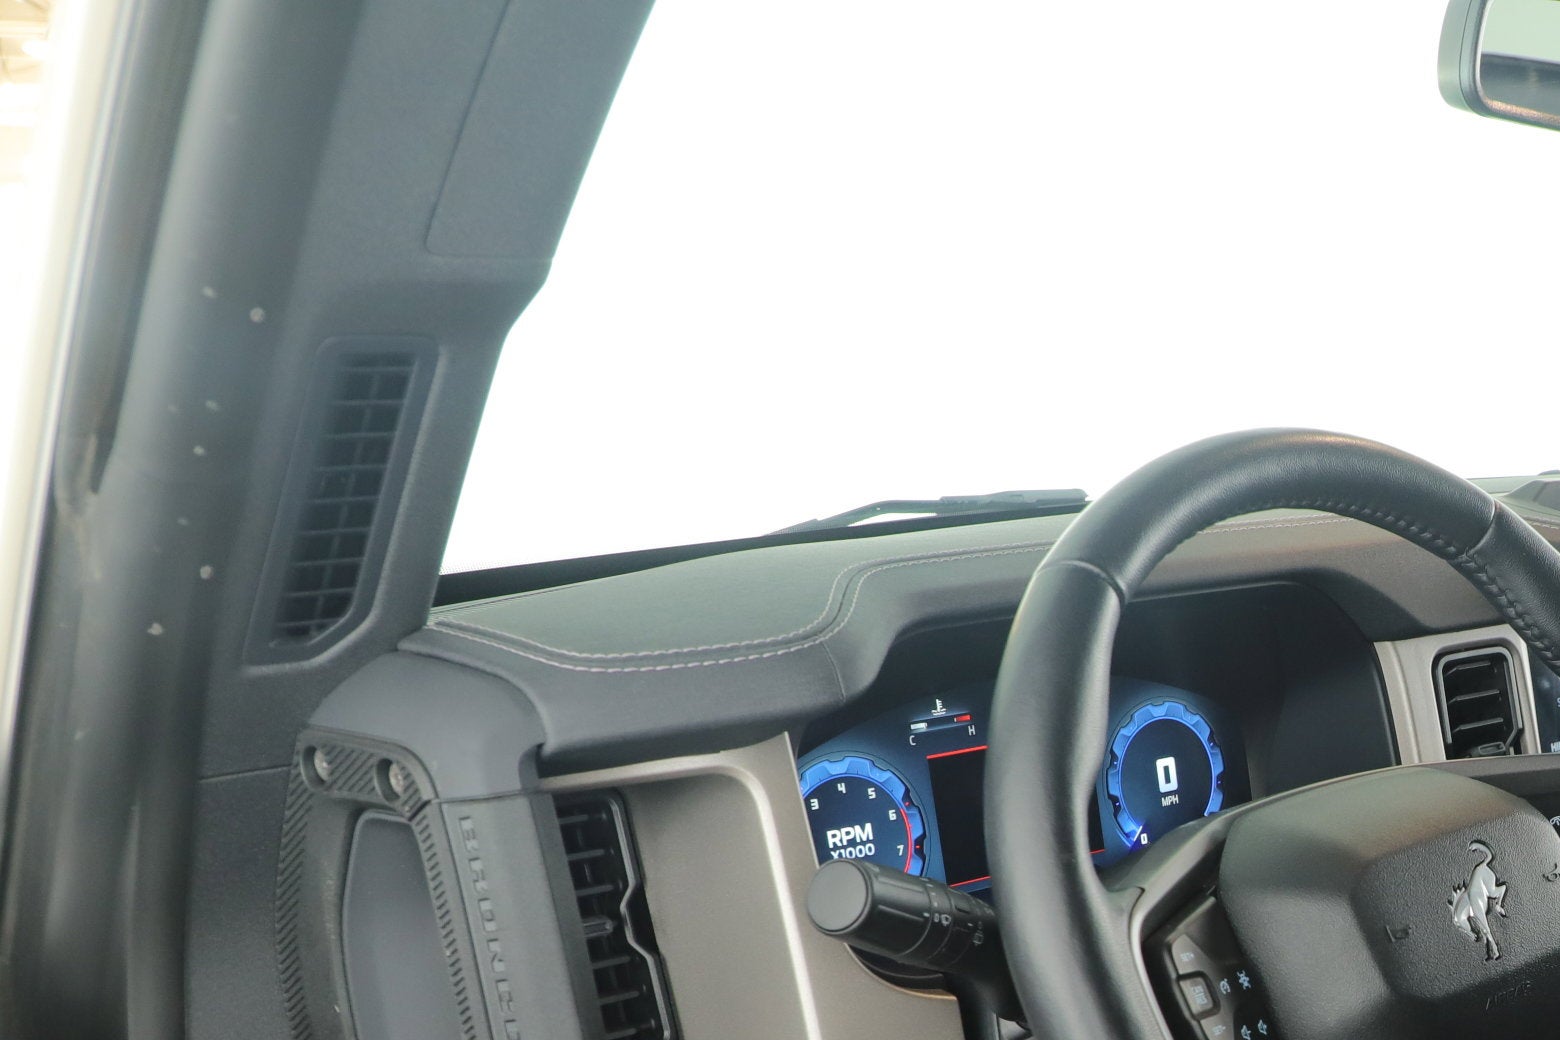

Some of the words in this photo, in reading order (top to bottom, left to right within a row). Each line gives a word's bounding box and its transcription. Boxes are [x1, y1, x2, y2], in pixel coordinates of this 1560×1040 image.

[968, 725, 976, 736] H
[909, 735, 917, 746] C
[1156, 756, 1178, 793] 0
[837, 782, 847, 794] 4
[867, 787, 877, 800] 5
[810, 798, 820, 811] 3
[1161, 794, 1179, 807] MPH
[888, 809, 897, 821] 6
[826, 822, 874, 849] RPM
[1140, 833, 1148, 845] 0
[896, 844, 904, 857] 7
